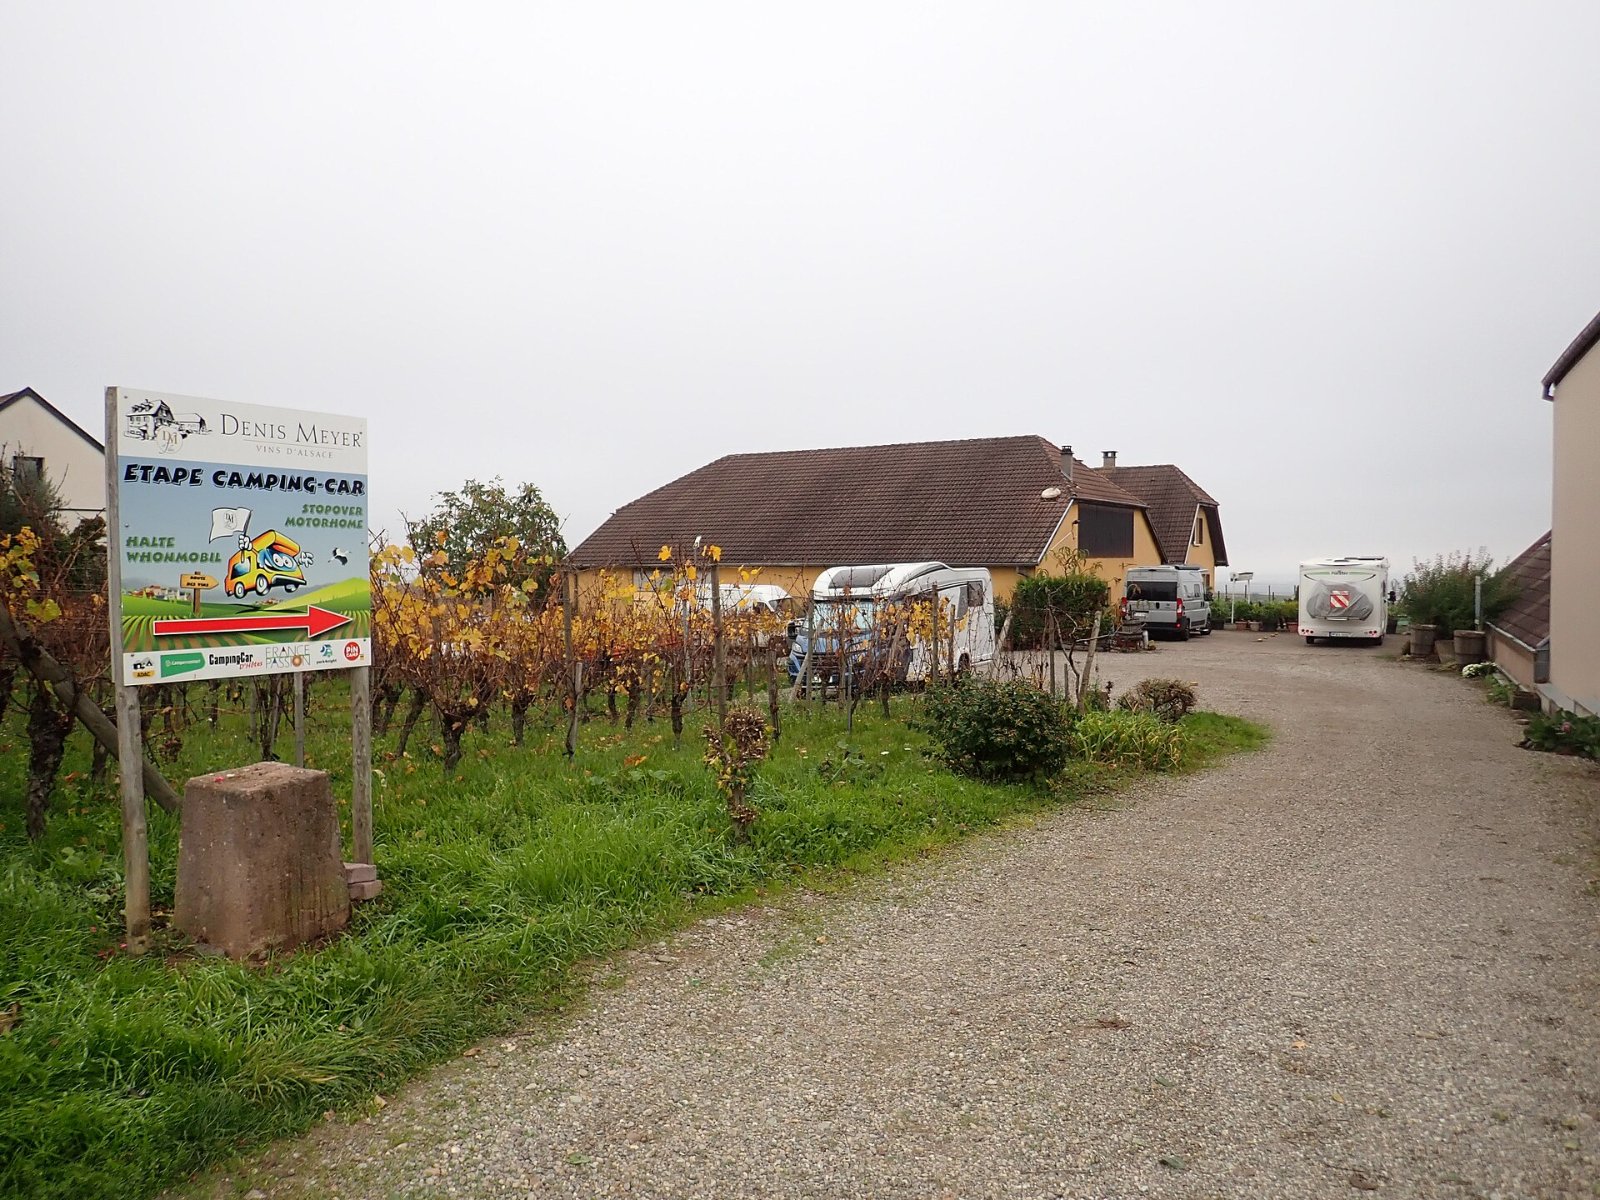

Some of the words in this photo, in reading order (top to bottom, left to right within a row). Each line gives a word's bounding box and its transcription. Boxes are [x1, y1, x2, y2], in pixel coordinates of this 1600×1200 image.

[220, 414, 286, 440] DENIS
[295, 422, 362, 448] MEYER
[256, 445, 281, 455] VINS
[286, 448, 334, 459] D'ALSACE
[123, 463, 203, 486] ETAPE
[212, 470, 366, 496] CAMPING-CAR
[301, 503, 363, 516] STOPOVER
[284, 516, 364, 530] MOTORHOME
[125, 536, 176, 548] HALTE
[126, 551, 222, 564] WHONMOBIL
[265, 644, 310, 658] FRANCE
[208, 651, 254, 666] CampingCar
